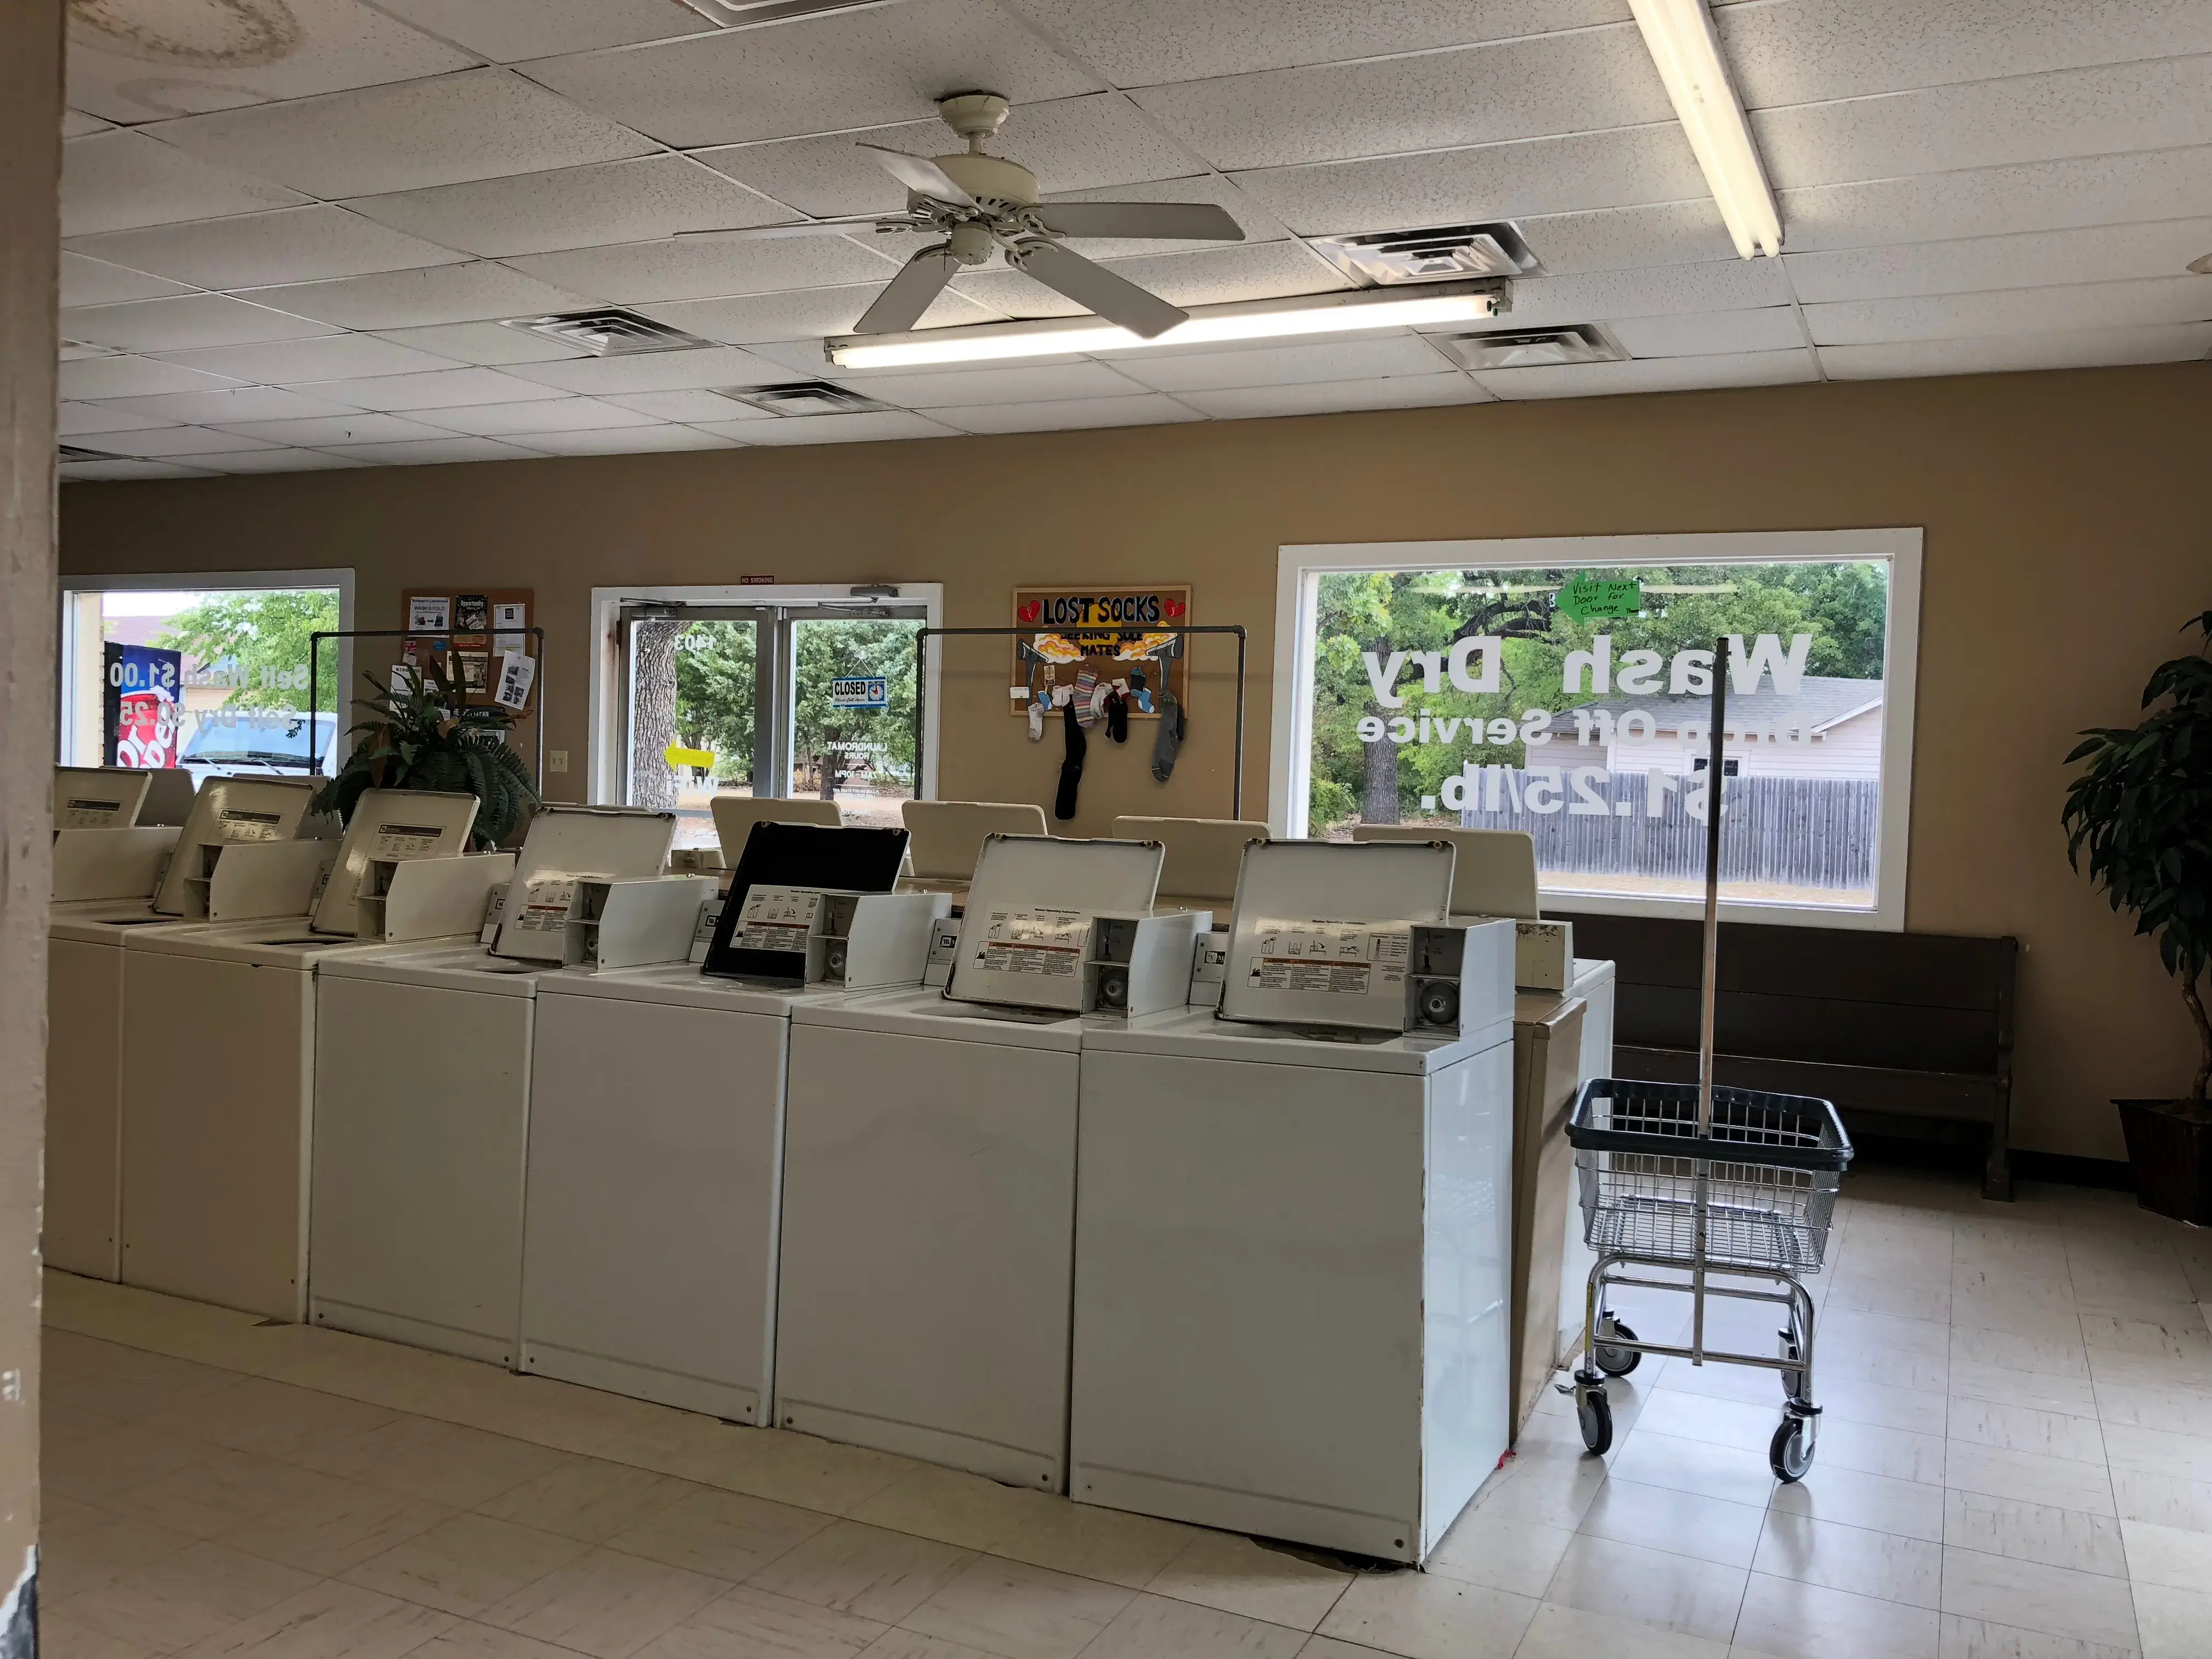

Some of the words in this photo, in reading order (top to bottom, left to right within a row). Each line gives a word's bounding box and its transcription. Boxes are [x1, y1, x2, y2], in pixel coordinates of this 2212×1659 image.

[1573, 582, 1601, 595] Visit
[1608, 582, 1637, 591] Next
[1573, 595, 1599, 606] Door
[1042, 596, 1095, 624] LOST
[1097, 595, 1160, 624] SOCKS
[1581, 605, 1619, 614] Change
[1081, 645, 1121, 656] MATES
[835, 681, 865, 695] CLOSED
